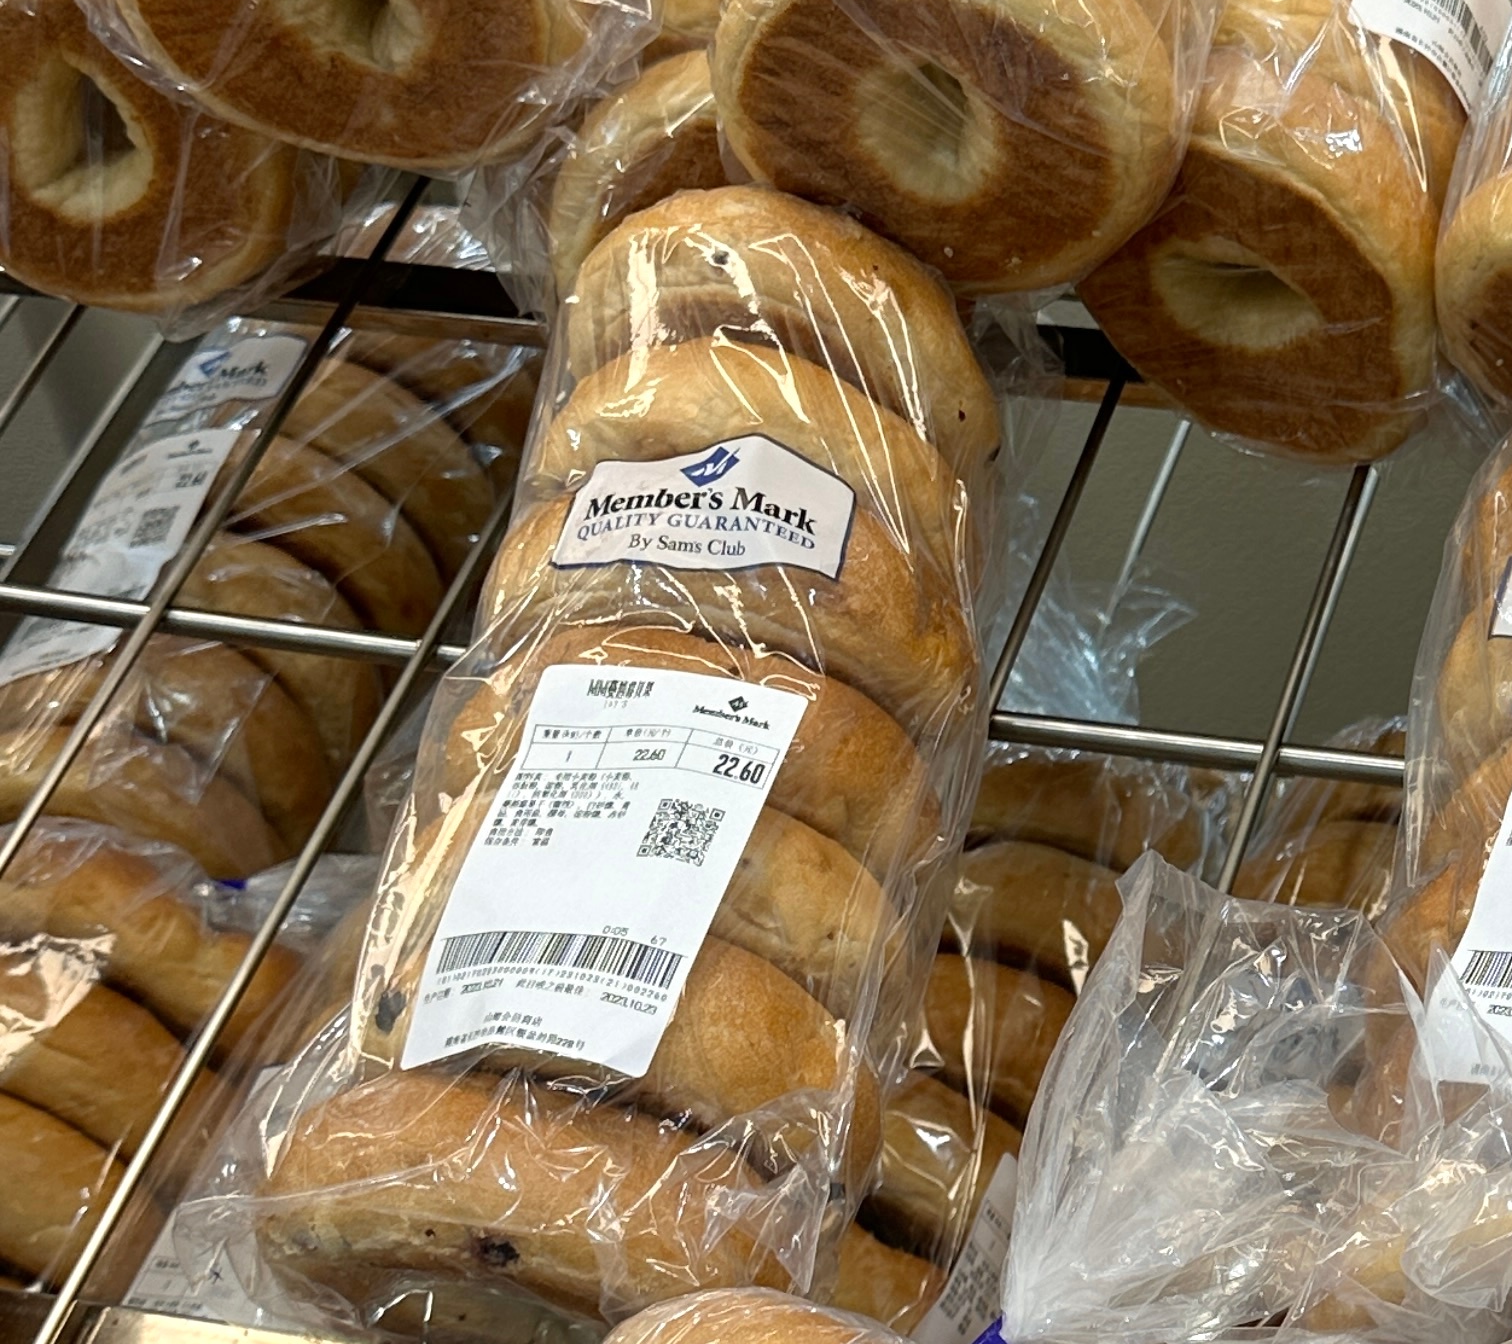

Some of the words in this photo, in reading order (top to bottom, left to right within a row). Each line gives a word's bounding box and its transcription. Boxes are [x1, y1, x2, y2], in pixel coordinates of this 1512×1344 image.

[584, 487, 724, 521] Member's
[729, 487, 817, 535] Mark
[577, 512, 666, 541] QUALITY
[667, 513, 815, 550] GUARANTEED
[629, 533, 651, 551] By
[657, 536, 702, 554] Sam's
[707, 538, 745, 556] Club
[742, 717, 771, 730] Mark
[632, 749, 666, 761] 22.60
[712, 753, 766, 784] 22.60
[650, 934, 667, 947] 67
